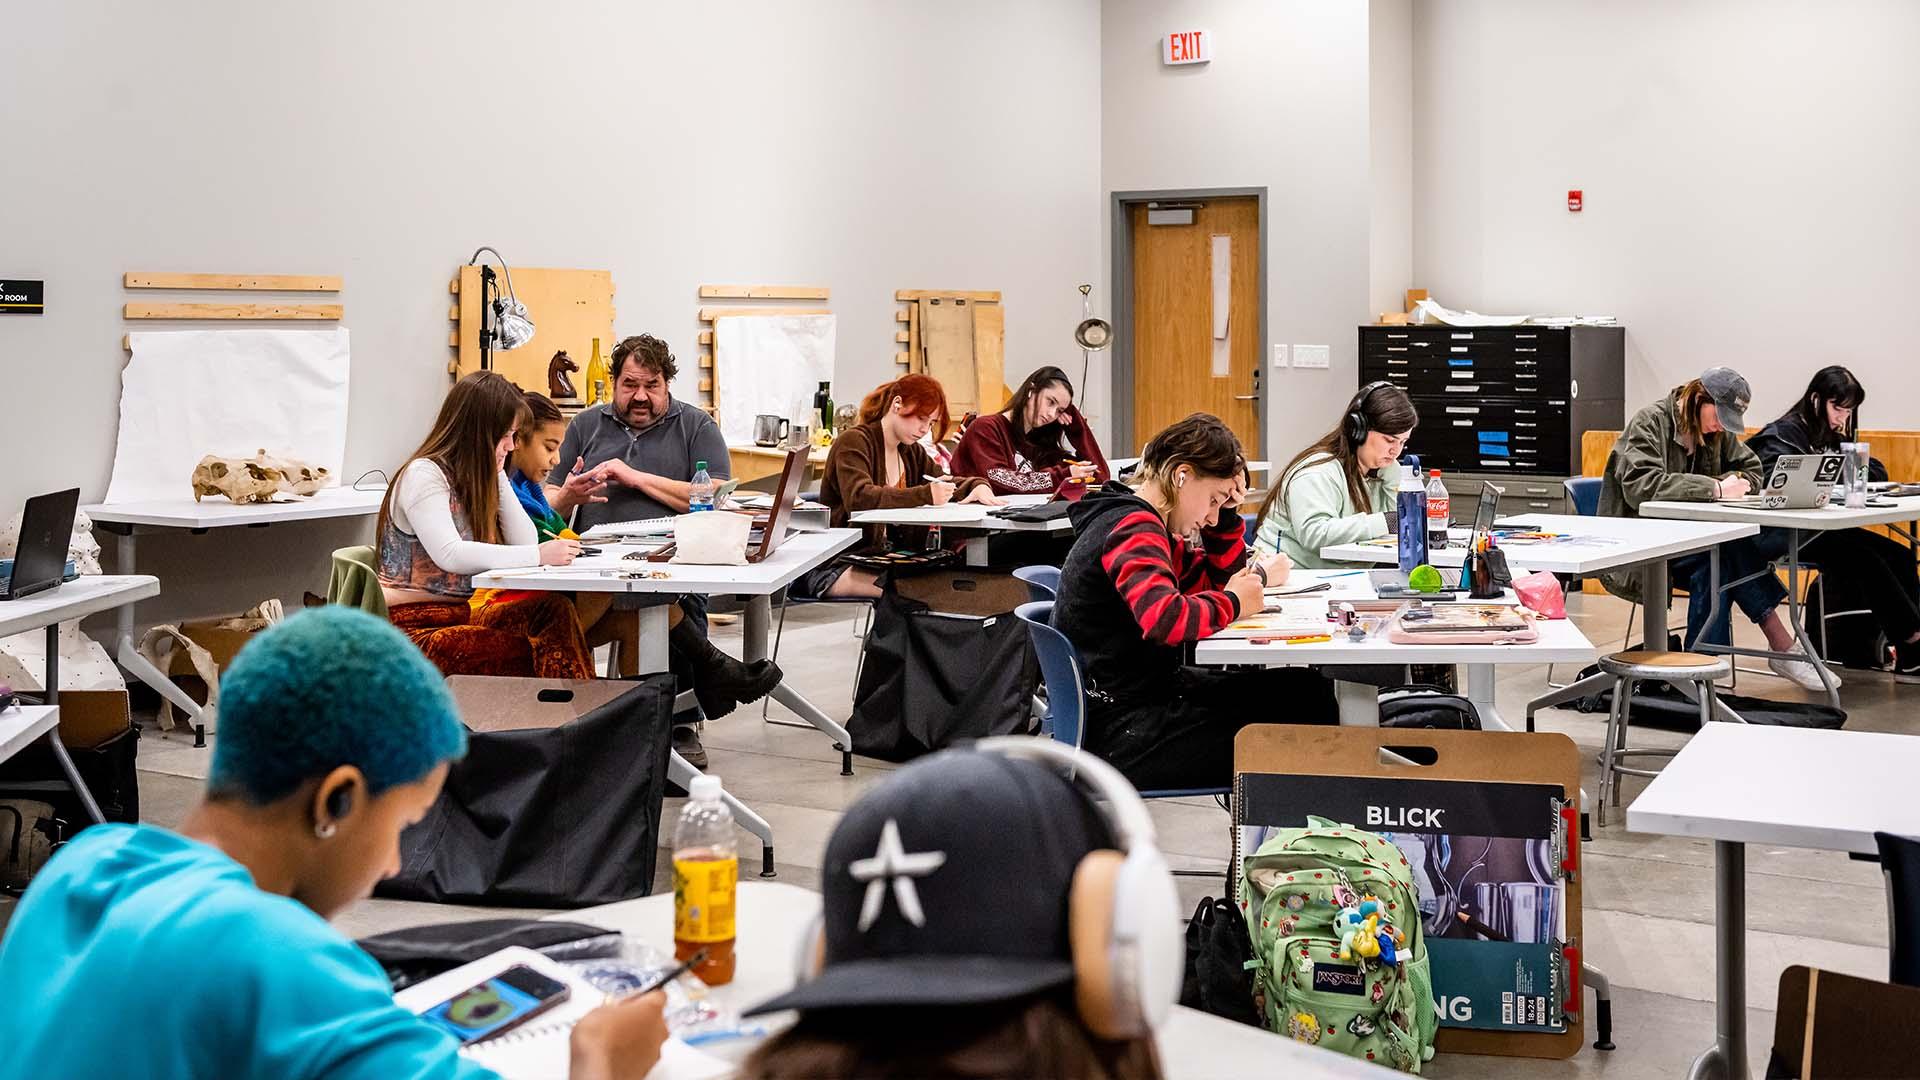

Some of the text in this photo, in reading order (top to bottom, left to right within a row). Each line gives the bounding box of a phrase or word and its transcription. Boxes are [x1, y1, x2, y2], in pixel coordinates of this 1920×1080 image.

[1170, 32, 1202, 61] EXIT
[5, 294, 28, 302] ROOM
[1366, 805, 1442, 828] BLICK
[1527, 999, 1535, 1022] 18x24
